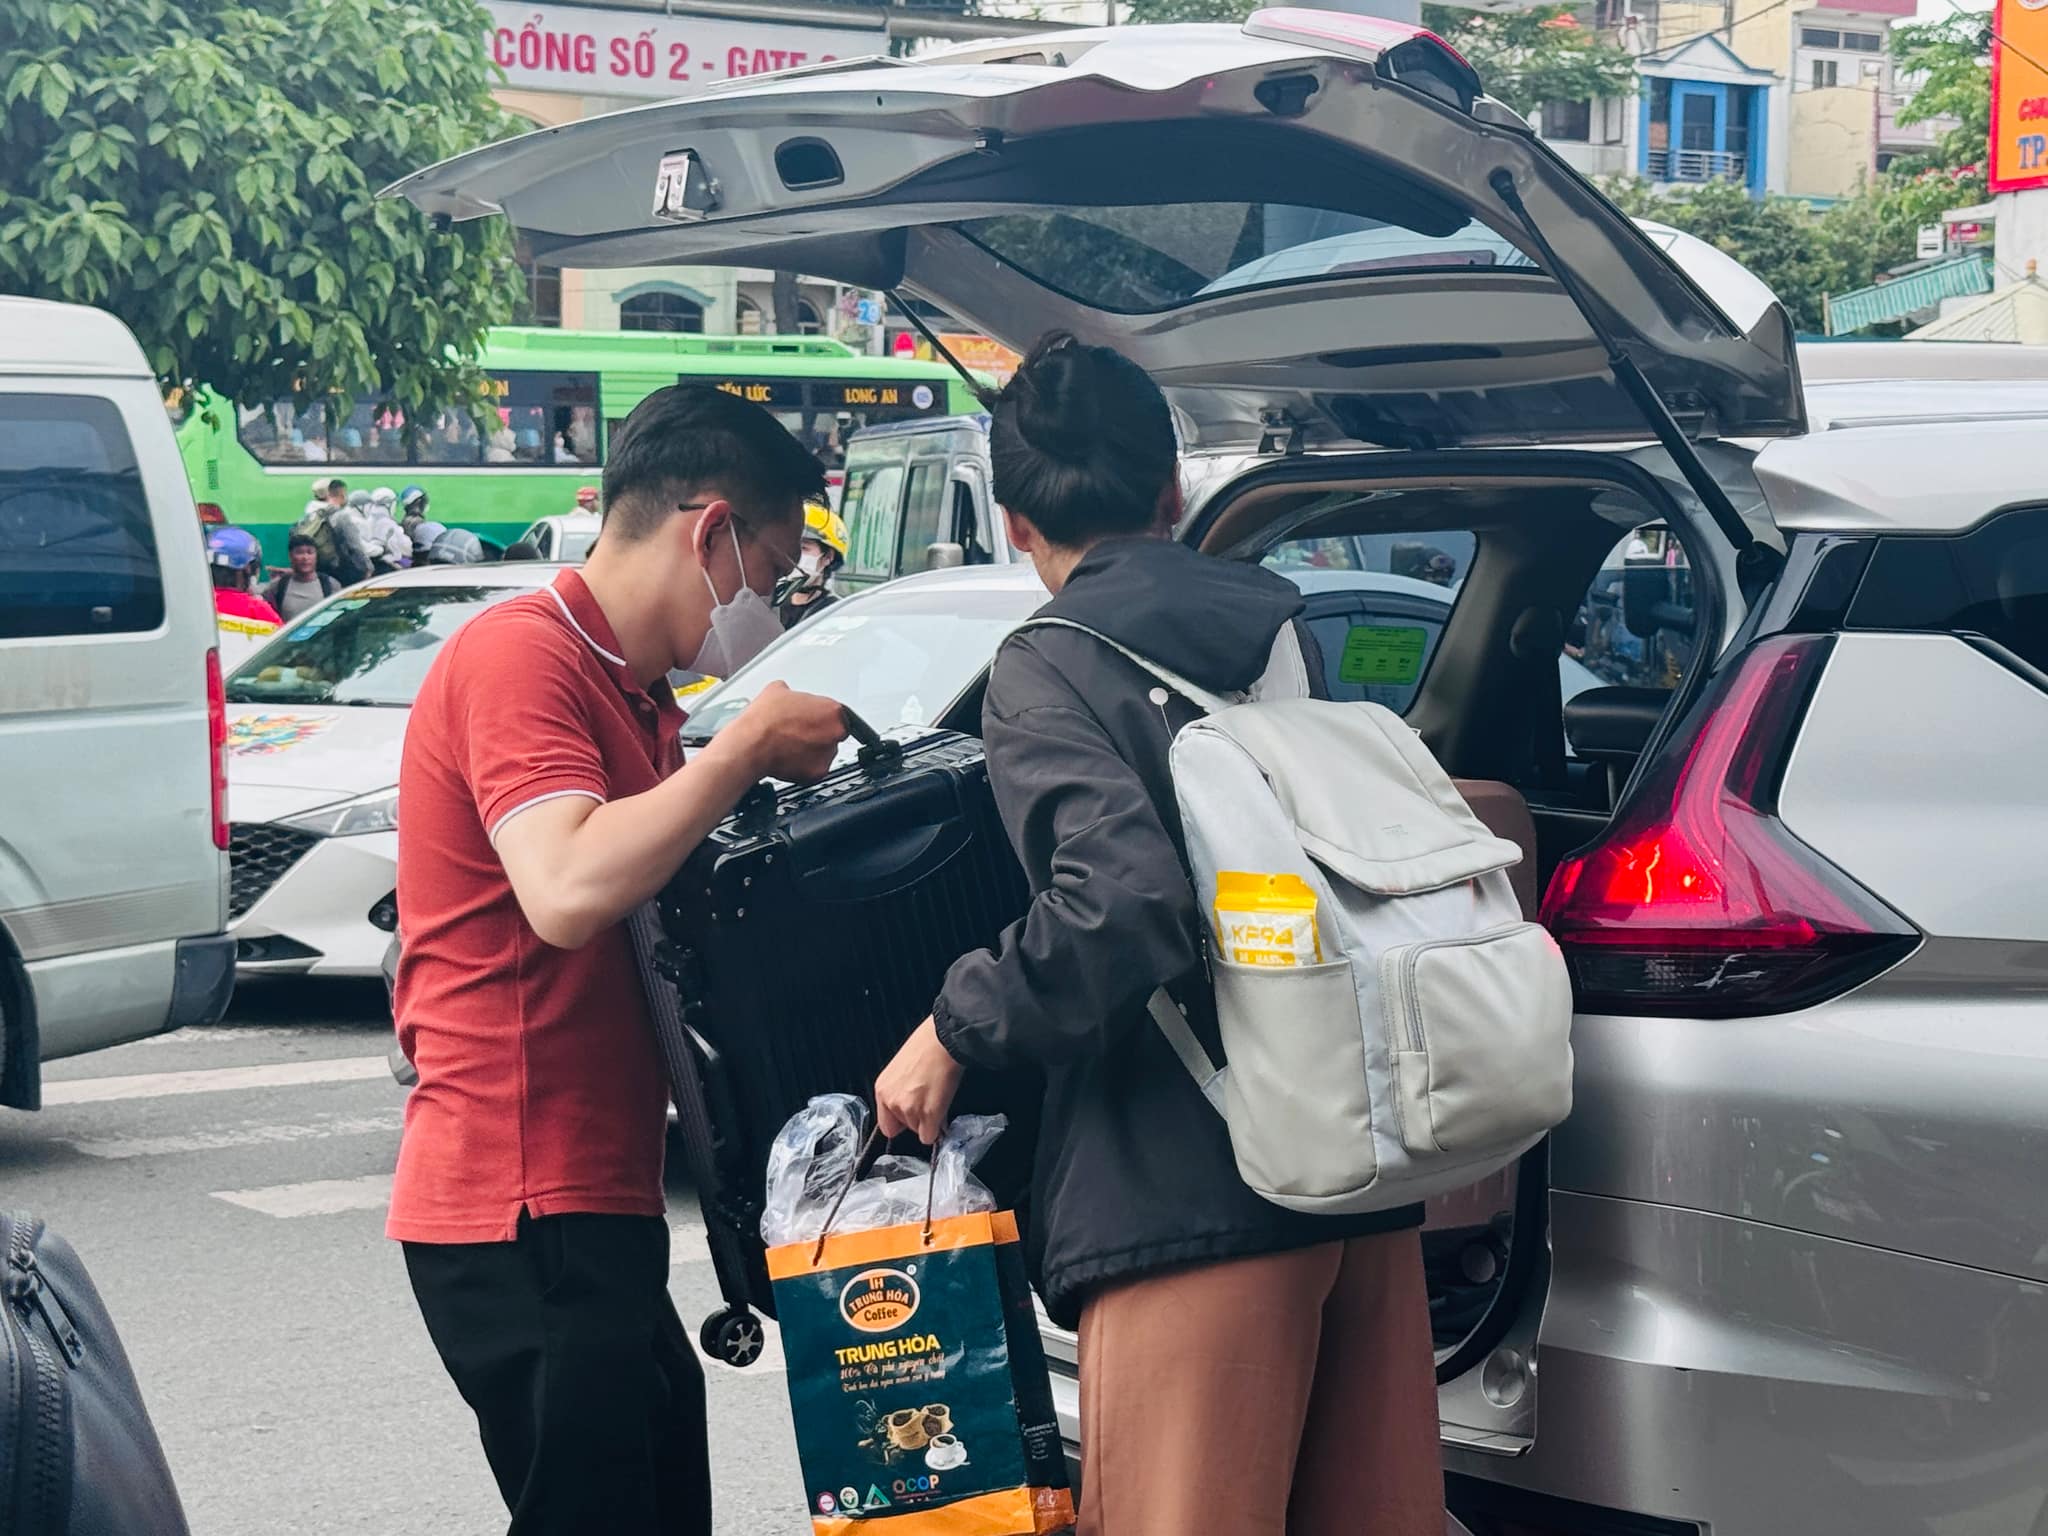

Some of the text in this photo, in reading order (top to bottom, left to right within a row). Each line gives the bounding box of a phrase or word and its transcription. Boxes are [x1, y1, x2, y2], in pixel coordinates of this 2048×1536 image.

[494, 14, 596, 74] CỔNG
[610, 28, 656, 78] SỐ
[669, 43, 690, 81] 2
[844, 388, 877, 403] LONG
[880, 388, 899, 404] AN
[1232, 924, 1294, 945] KF94
[848, 1289, 884, 1312] TRUNG
[864, 1307, 899, 1321] Coffee
[834, 1333, 942, 1365] TRUNG HÒA
[893, 1474, 940, 1494] OCOP
